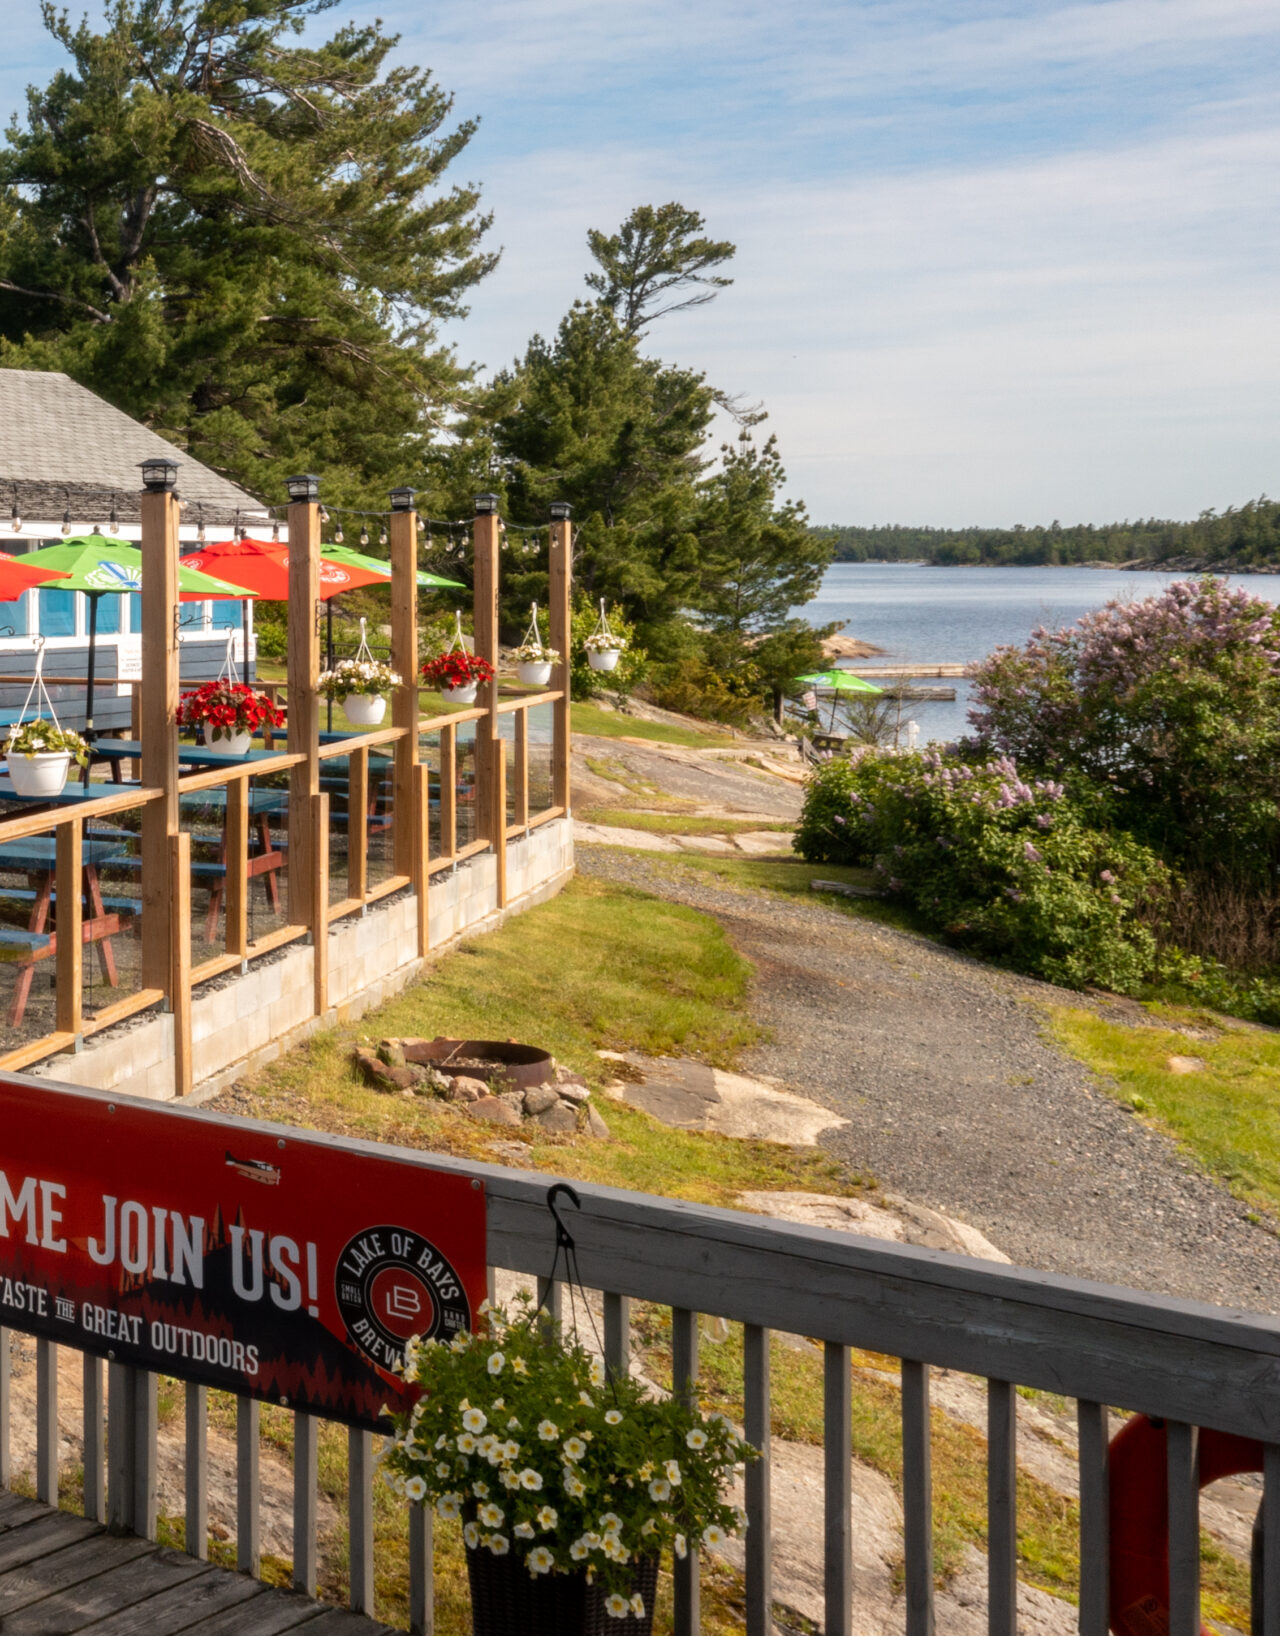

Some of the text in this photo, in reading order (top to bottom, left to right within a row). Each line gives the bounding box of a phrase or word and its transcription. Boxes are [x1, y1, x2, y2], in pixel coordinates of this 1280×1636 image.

[87, 1194, 205, 1290] JOIN
[228, 1224, 319, 1318] US!
[343, 1233, 460, 1300] LAKE OF BAYS
[55, 1299, 75, 1320] THE
[82, 1302, 143, 1345] GREAT
[151, 1321, 259, 1375] OUTDOORS
[352, 1318, 409, 1369] BREW
